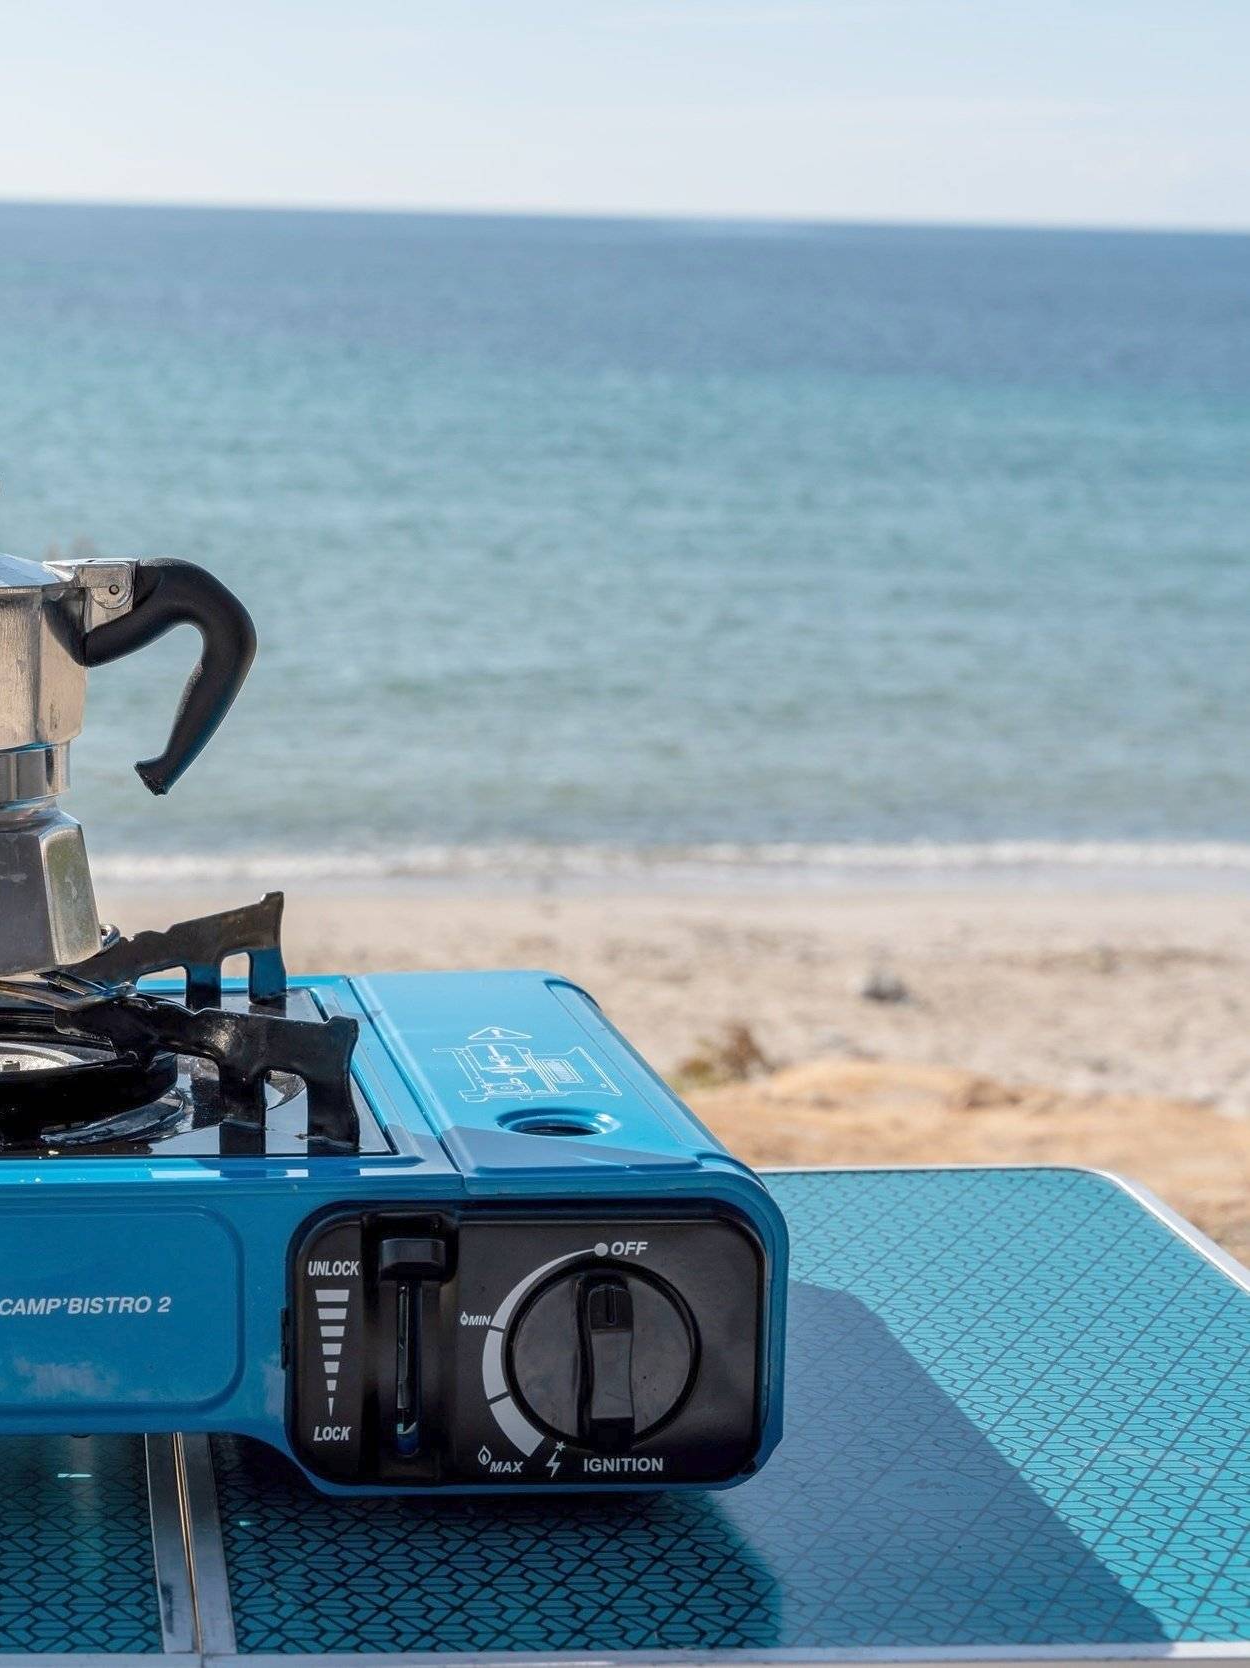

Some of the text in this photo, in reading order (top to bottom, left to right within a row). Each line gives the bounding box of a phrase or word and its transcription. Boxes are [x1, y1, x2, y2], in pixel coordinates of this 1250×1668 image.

[611, 1241, 648, 1256] OFF
[308, 1260, 360, 1276] UNLOCK
[157, 1296, 172, 1313] 2
[468, 1315, 491, 1326] MIN
[313, 1426, 352, 1442] LOCK
[489, 1461, 524, 1473] MAX
[583, 1458, 664, 1472] IGNITION
